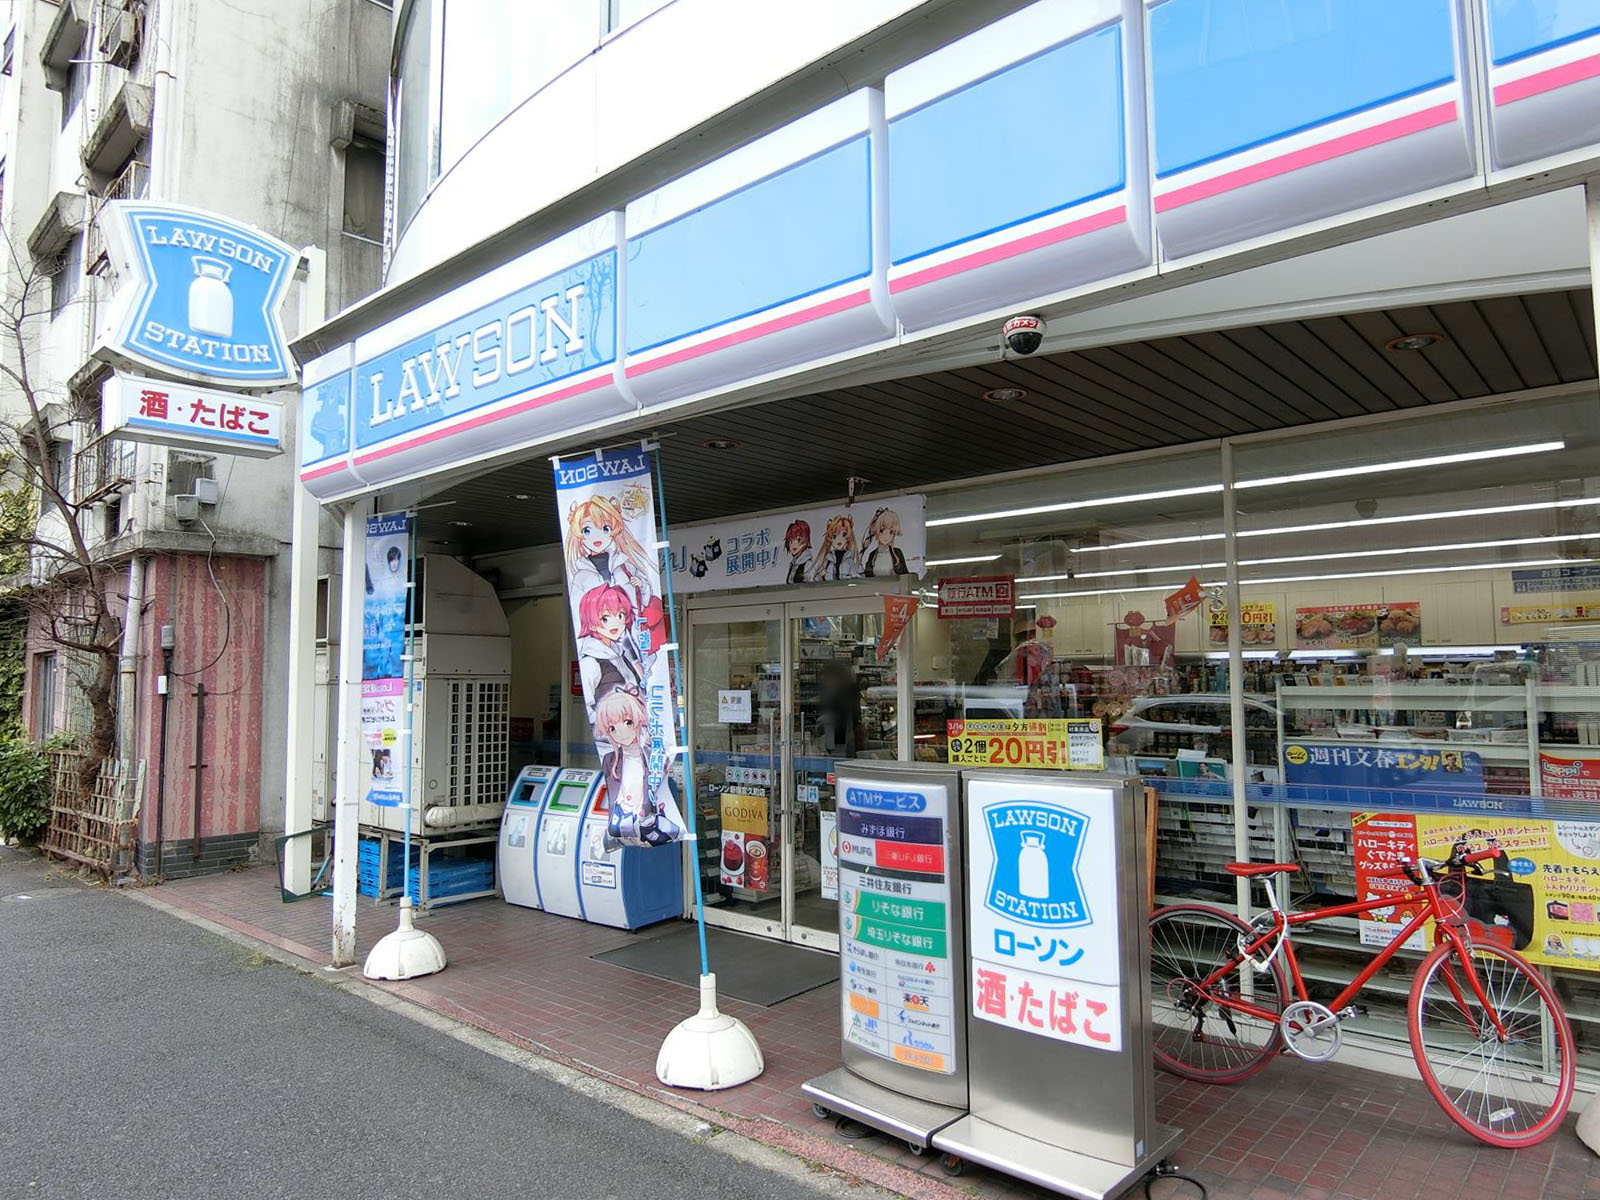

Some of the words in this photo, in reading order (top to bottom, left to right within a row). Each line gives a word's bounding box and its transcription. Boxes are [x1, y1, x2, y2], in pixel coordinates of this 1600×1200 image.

[146, 226, 274, 274] LAWSON
[143, 321, 272, 363] STATION
[369, 282, 586, 428] LAWSON
[726, 546, 779, 577] 展開中!
[989, 737, 1066, 764] 20円引
[724, 806, 763, 820] GODIVA
[849, 791, 921, 810] ATMサービス
[1452, 797, 1504, 810] LAWSON
[860, 823, 905, 839] みずほ銀行
[992, 809, 1079, 837] LAWSON
[852, 844, 872, 857] MUFG
[1357, 839, 1414, 851] ハローキティ
[859, 876, 912, 895] 三井住友銀行
[871, 900, 925, 920] りそな銀行
[994, 890, 1079, 920] STATION
[867, 926, 933, 949] 埼玉りそな銀行
[994, 928, 1085, 966] ローソン
[976, 967, 1111, 1044] 酒・たばこ
